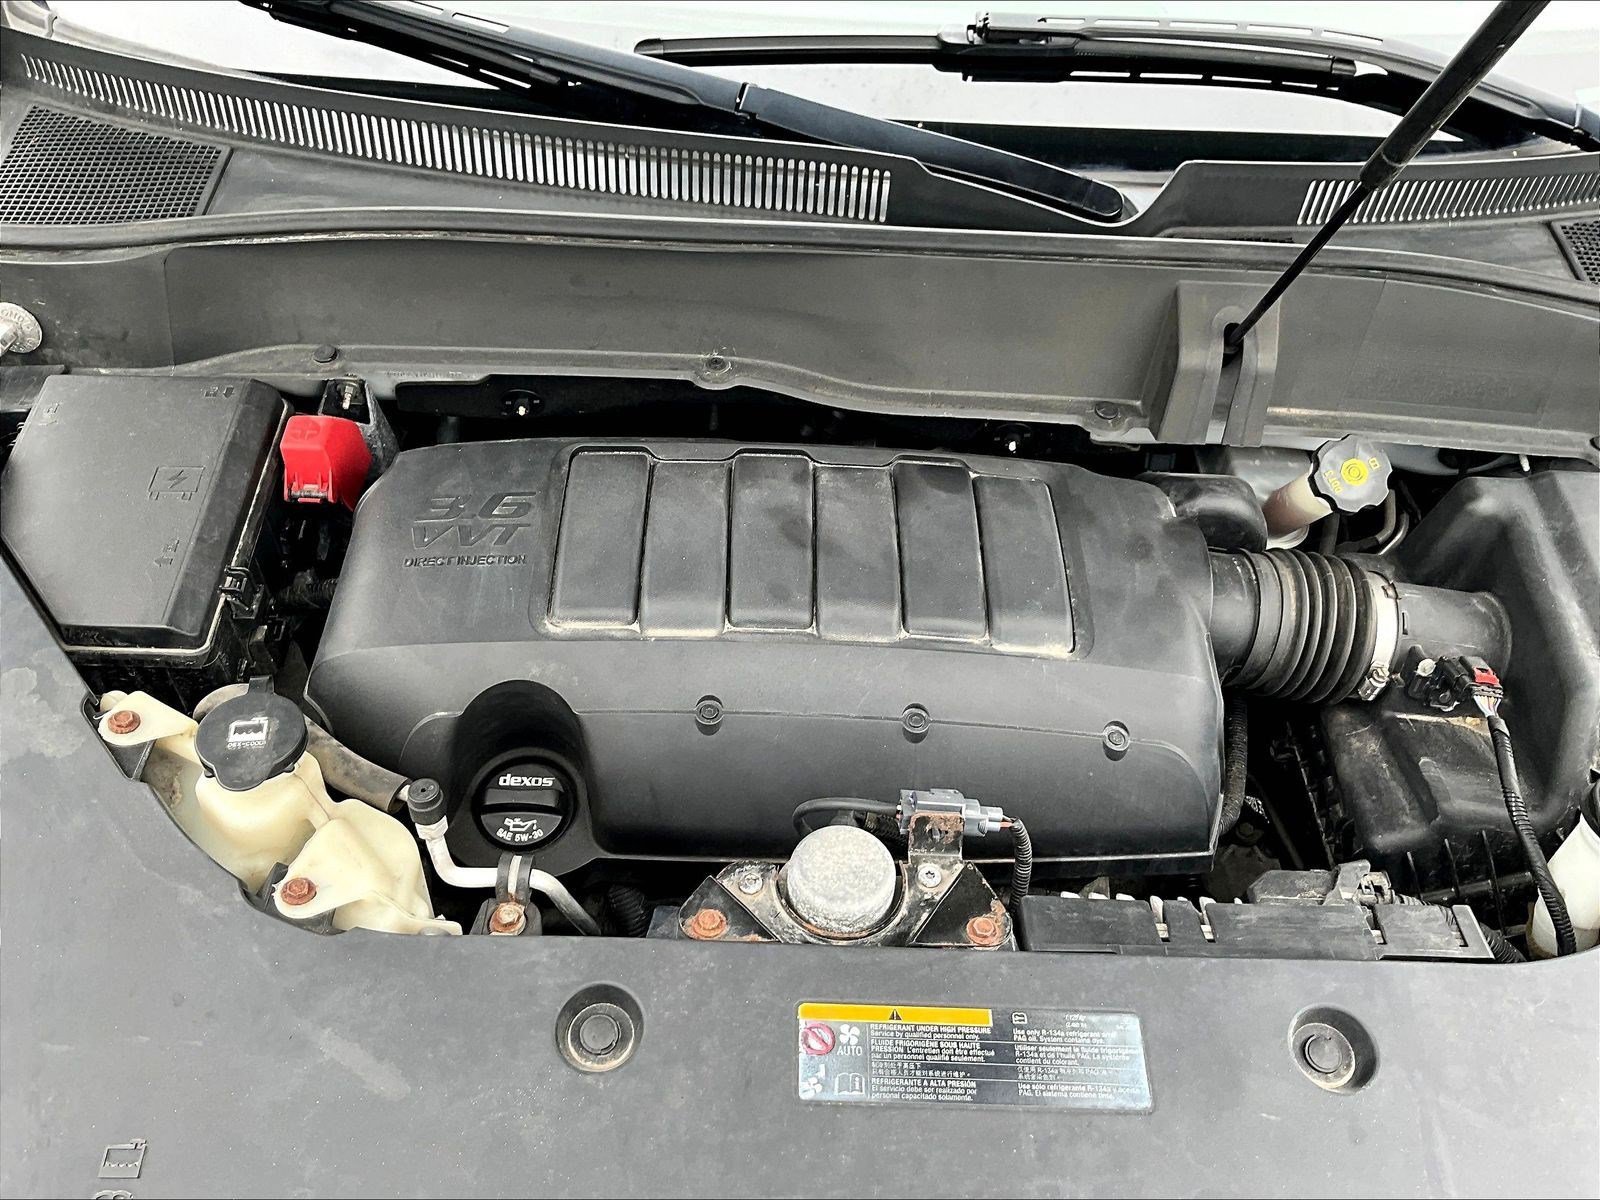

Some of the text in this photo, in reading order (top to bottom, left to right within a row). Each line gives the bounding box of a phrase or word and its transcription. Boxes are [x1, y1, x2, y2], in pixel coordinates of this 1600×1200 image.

[414, 491, 536, 523] 3.6
[412, 523, 531, 550] VVT
[403, 555, 526, 567] DIRECT INJECTION
[499, 774, 555, 786] dexos
[496, 828, 543, 842] SAE 5W-30
[870, 1023, 914, 1031] REFRIGERANT
[957, 1026, 991, 1034] PRESSURE
[905, 1031, 932, 1039] qualified
[933, 1033, 965, 1041] personnel
[1027, 1029, 1040, 1037] only
[1066, 1031, 1100, 1039] refrigerant
[895, 1039, 938, 1048] FRIGORIGÈNE
[1040, 1036, 1063, 1044] System
[837, 1046, 862, 1056] AUTO
[893, 1053, 924, 1061] personnel
[872, 1078, 921, 1086] REFRIGERANTE
[947, 1079, 976, 1088] PRESIÓN
[872, 1092, 900, 1100] personal
[901, 1092, 936, 1101] capacitado
